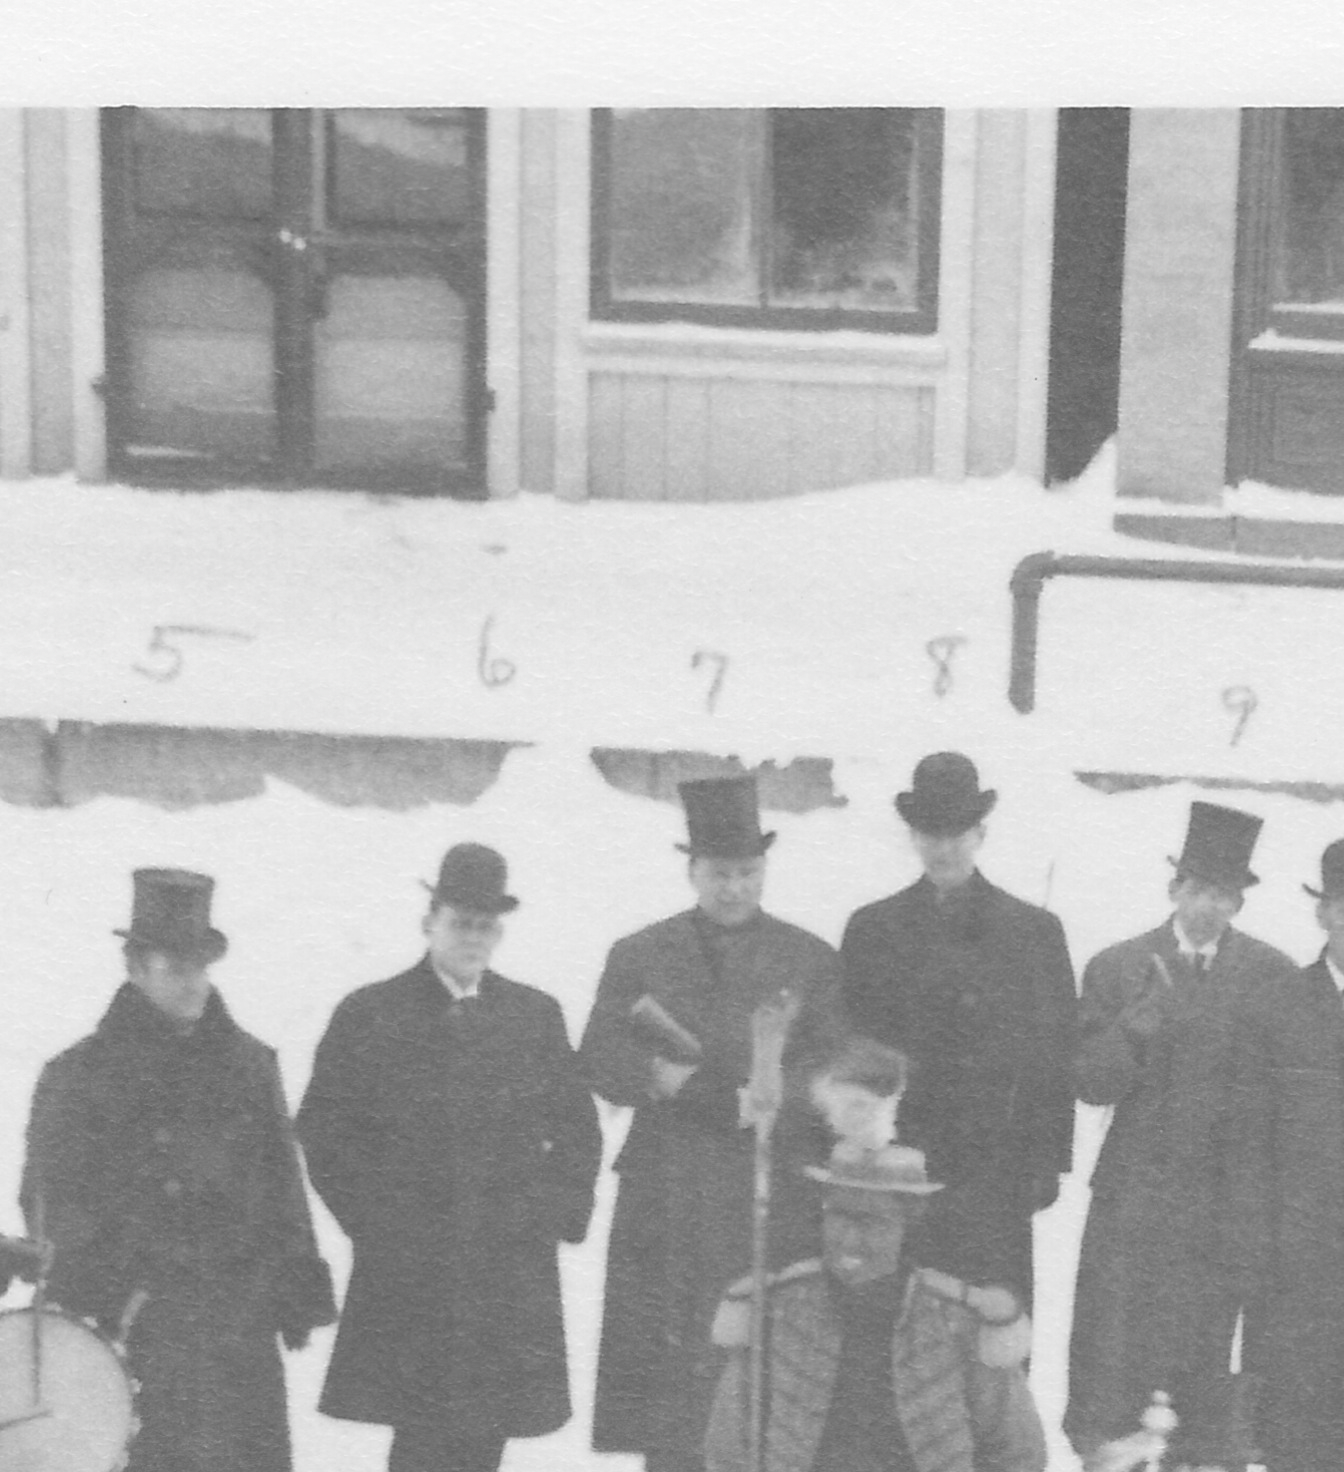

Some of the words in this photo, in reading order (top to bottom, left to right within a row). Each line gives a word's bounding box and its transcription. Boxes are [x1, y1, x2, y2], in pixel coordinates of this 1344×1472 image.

[133, 623, 251, 683] 5
[478, 618, 516, 688] 6
[690, 650, 728, 709] 7
[926, 637, 964, 697] 8
[1222, 688, 1258, 747] 9
